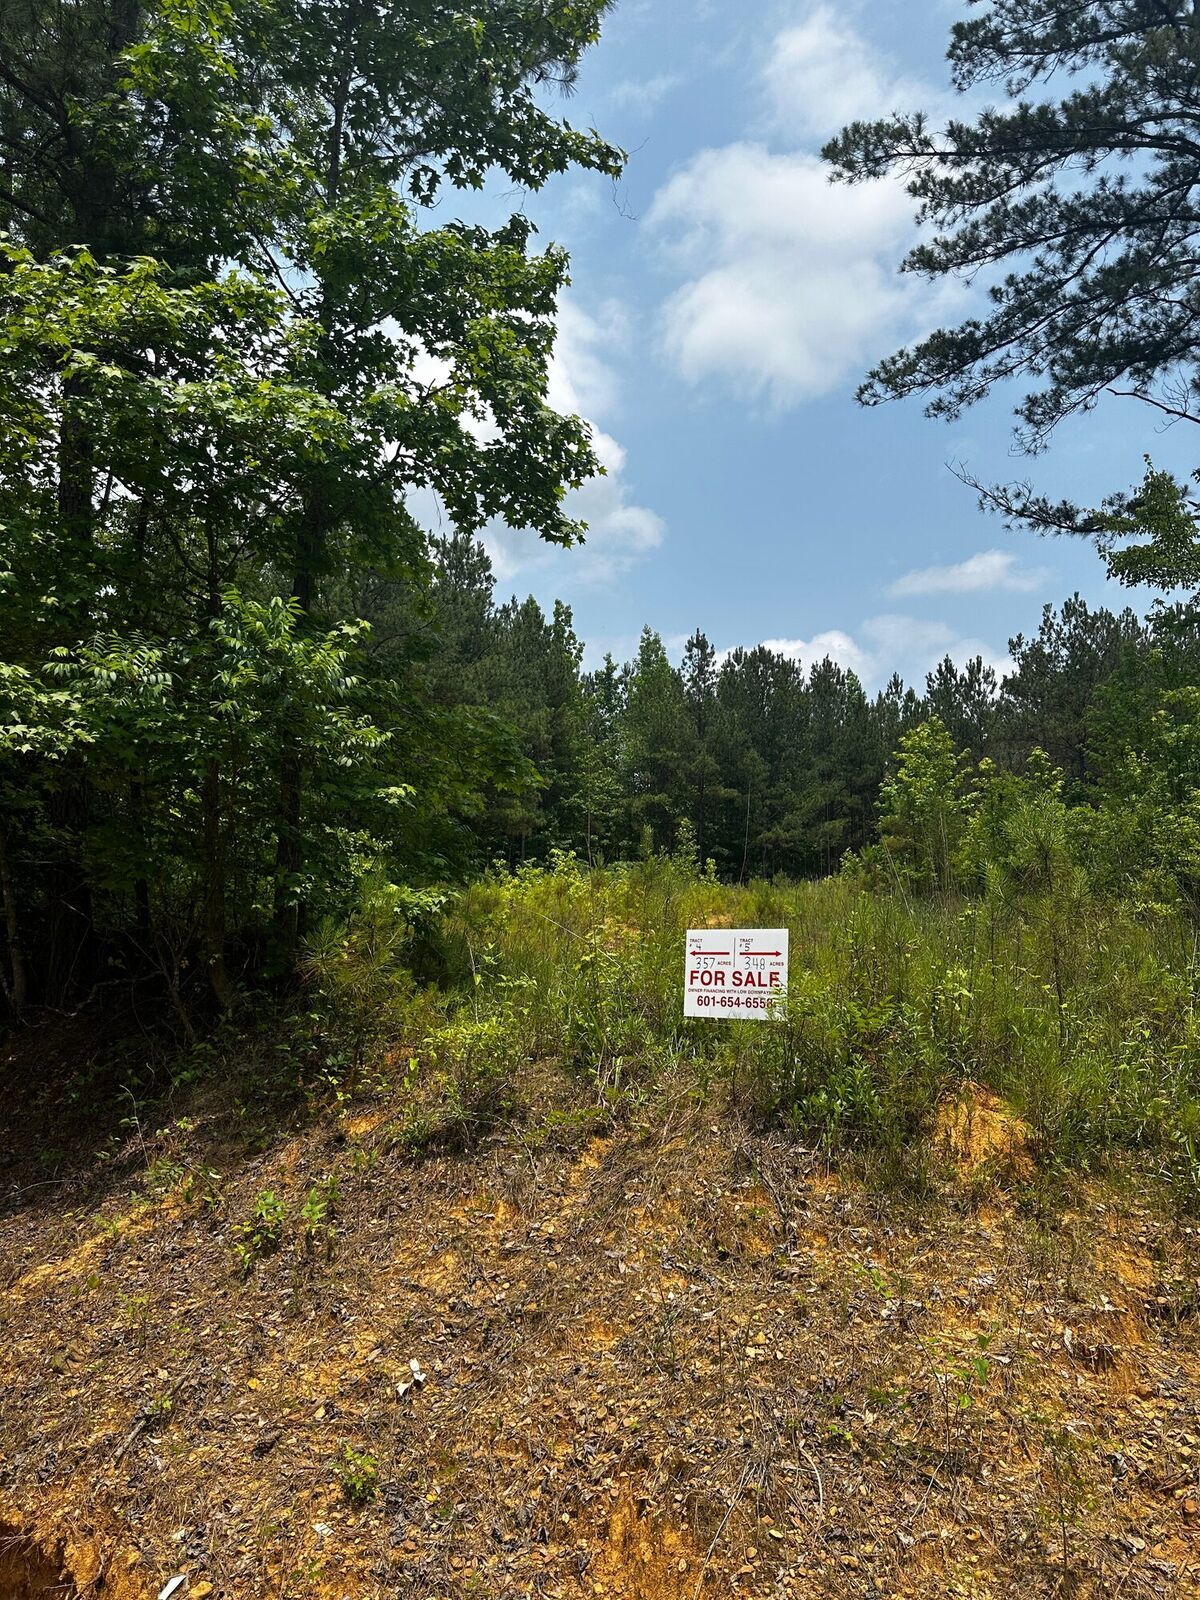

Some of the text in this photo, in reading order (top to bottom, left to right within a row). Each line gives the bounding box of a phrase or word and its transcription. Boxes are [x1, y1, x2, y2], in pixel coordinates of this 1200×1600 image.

[745, 943, 750, 951] 5
[690, 970, 780, 987] FOR SALE
